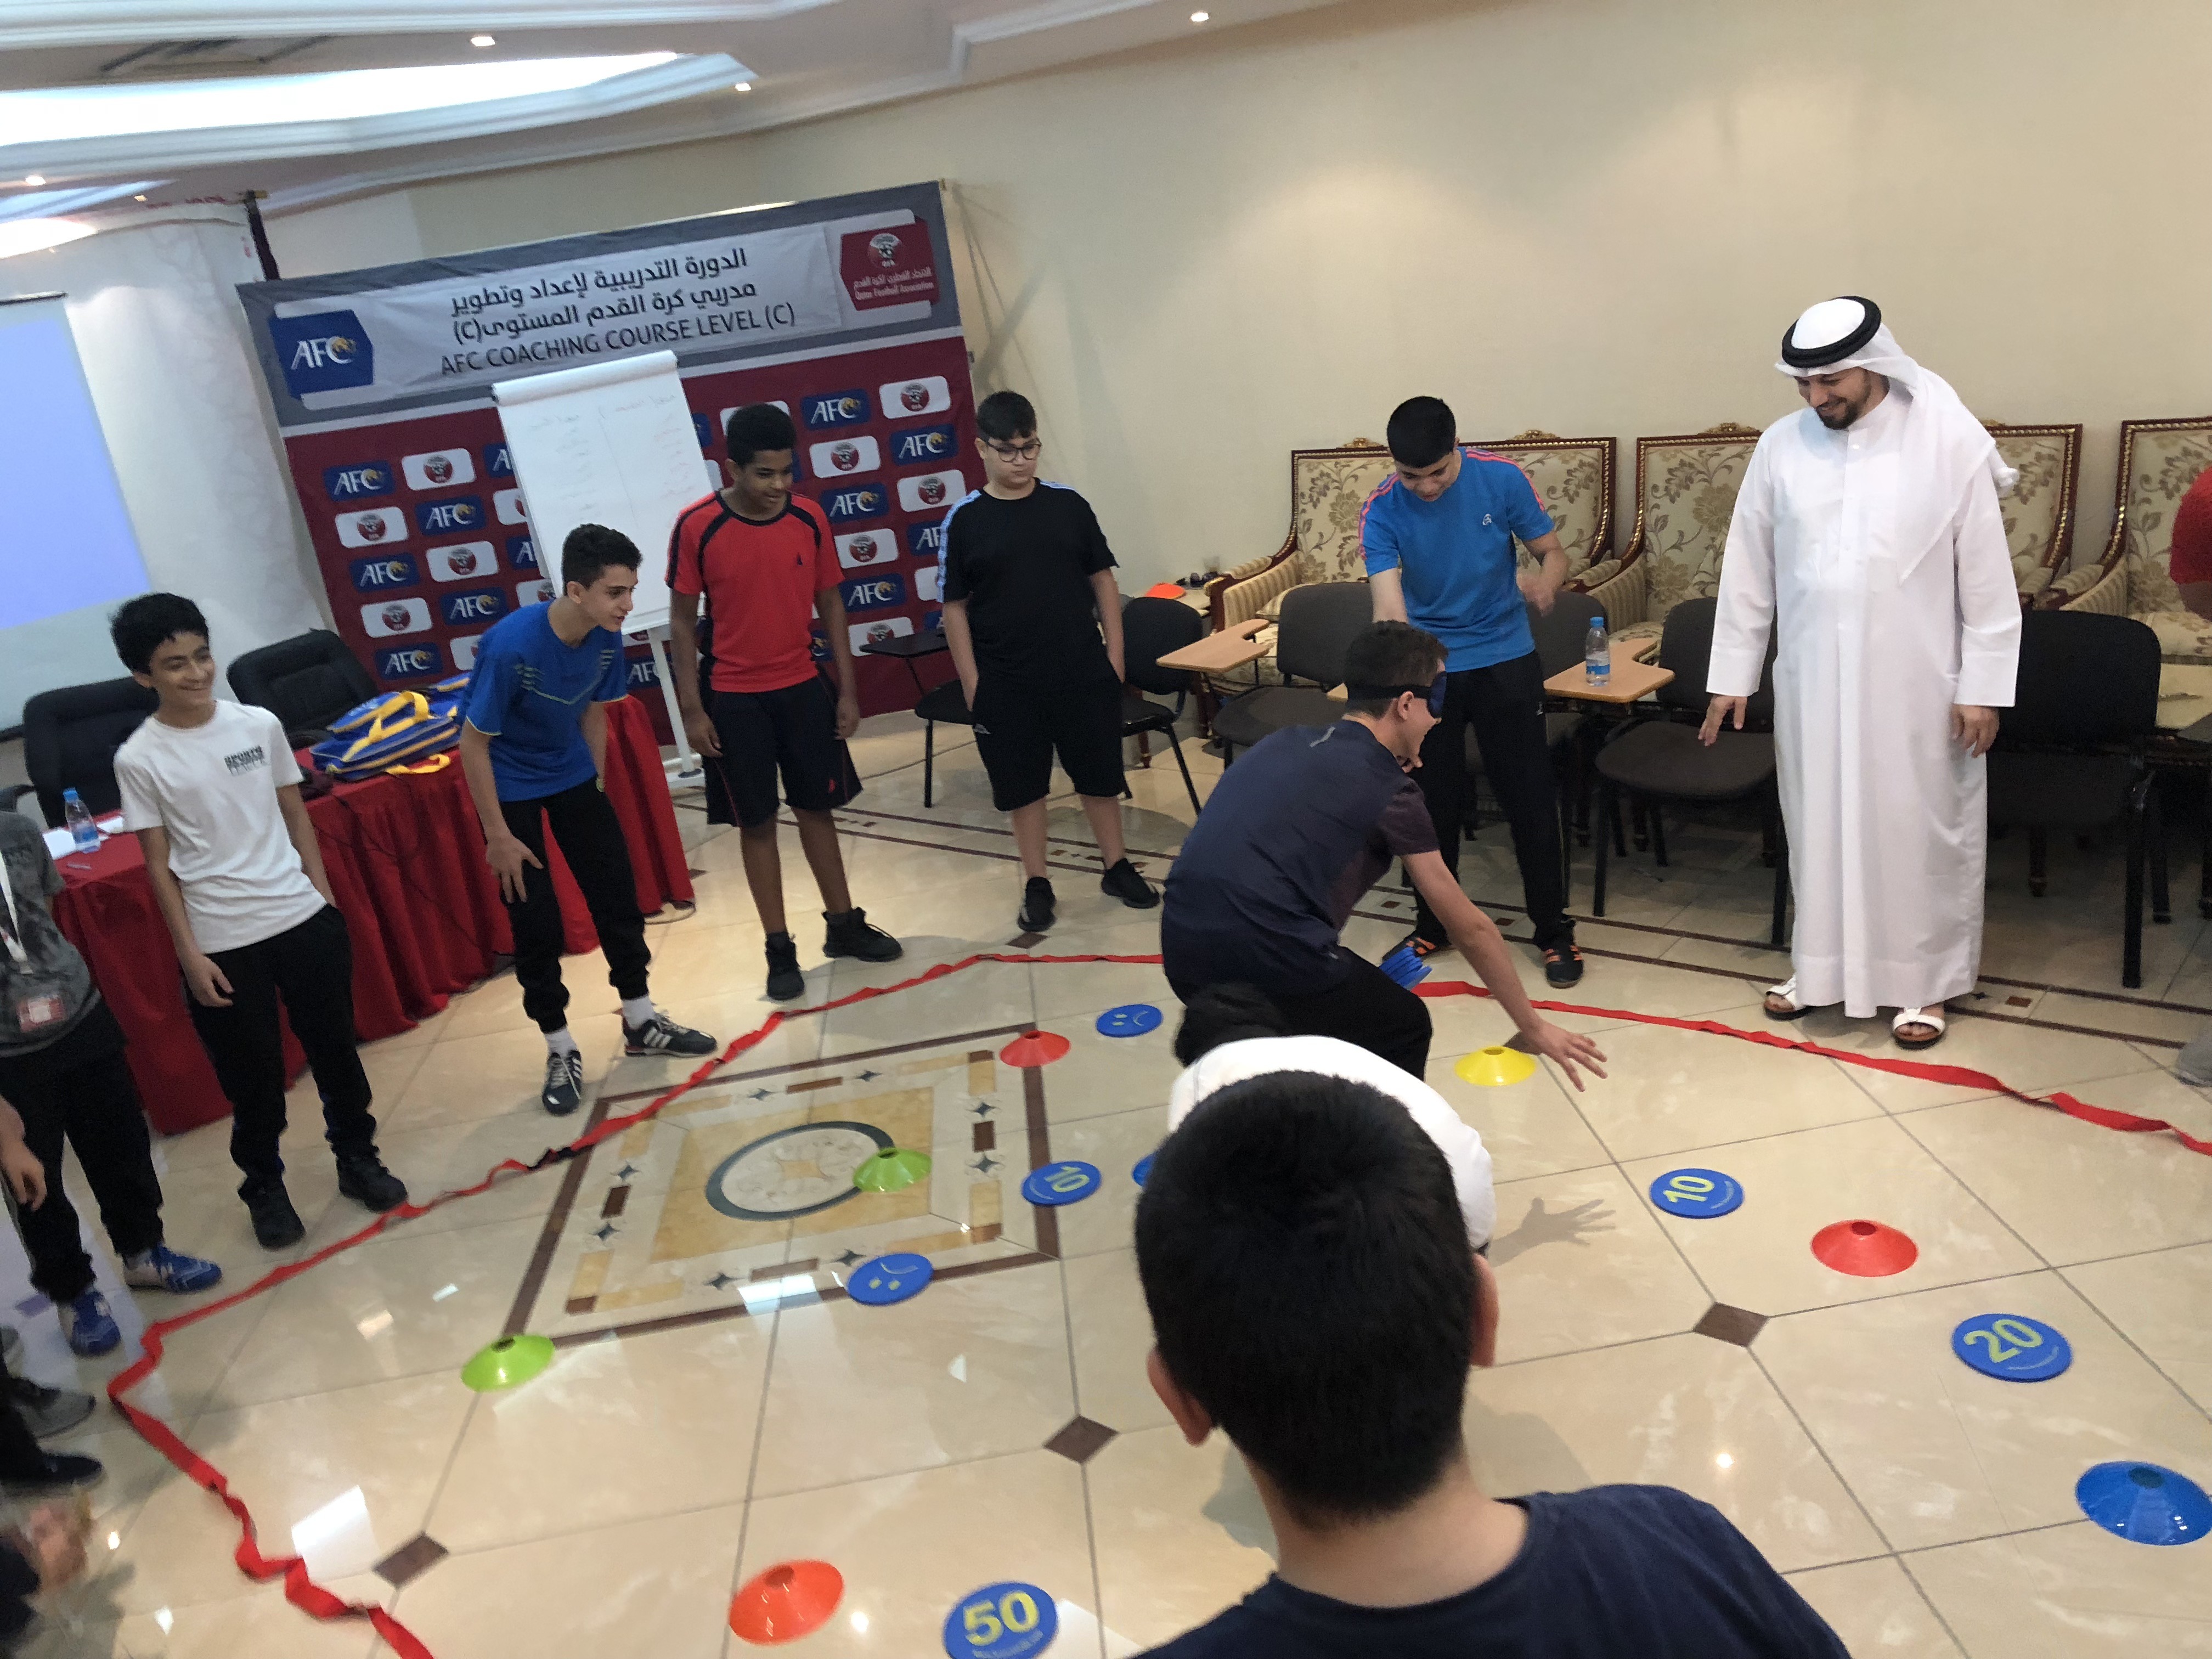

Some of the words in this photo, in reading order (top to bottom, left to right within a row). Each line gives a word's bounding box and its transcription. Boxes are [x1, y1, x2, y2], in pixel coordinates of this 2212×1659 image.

[594, 258, 680, 292] التدريبية
[685, 247, 748, 279] الدورة
[530, 272, 588, 298] لإعداد
[690, 283, 757, 309] مدربي
[451, 285, 524, 317] وتطوير
[586, 294, 647, 327] القدم
[652, 288, 685, 315] كرة
[441, 351, 483, 375] AFC
[486, 334, 601, 367] COACHING
[605, 319, 694, 350] COURSE
[696, 309, 761, 336] LEVEL
[765, 302, 795, 330] (C)
[291, 336, 357, 370] AFC
[810, 397, 860, 424] AFC
[899, 432, 949, 459] AFC
[334, 468, 383, 495] AFC
[426, 503, 476, 529] AFC
[829, 491, 878, 517] AFC
[360, 560, 408, 587] AFC
[450, 594, 499, 619] AFC
[848, 581, 896, 607] AFC
[385, 650, 433, 675] AFC
[1044, 1166, 1090, 1194] 10
[1663, 1175, 1716, 1203] 10
[1963, 1319, 2043, 1363] 20
[962, 1590, 1040, 1646] 50
